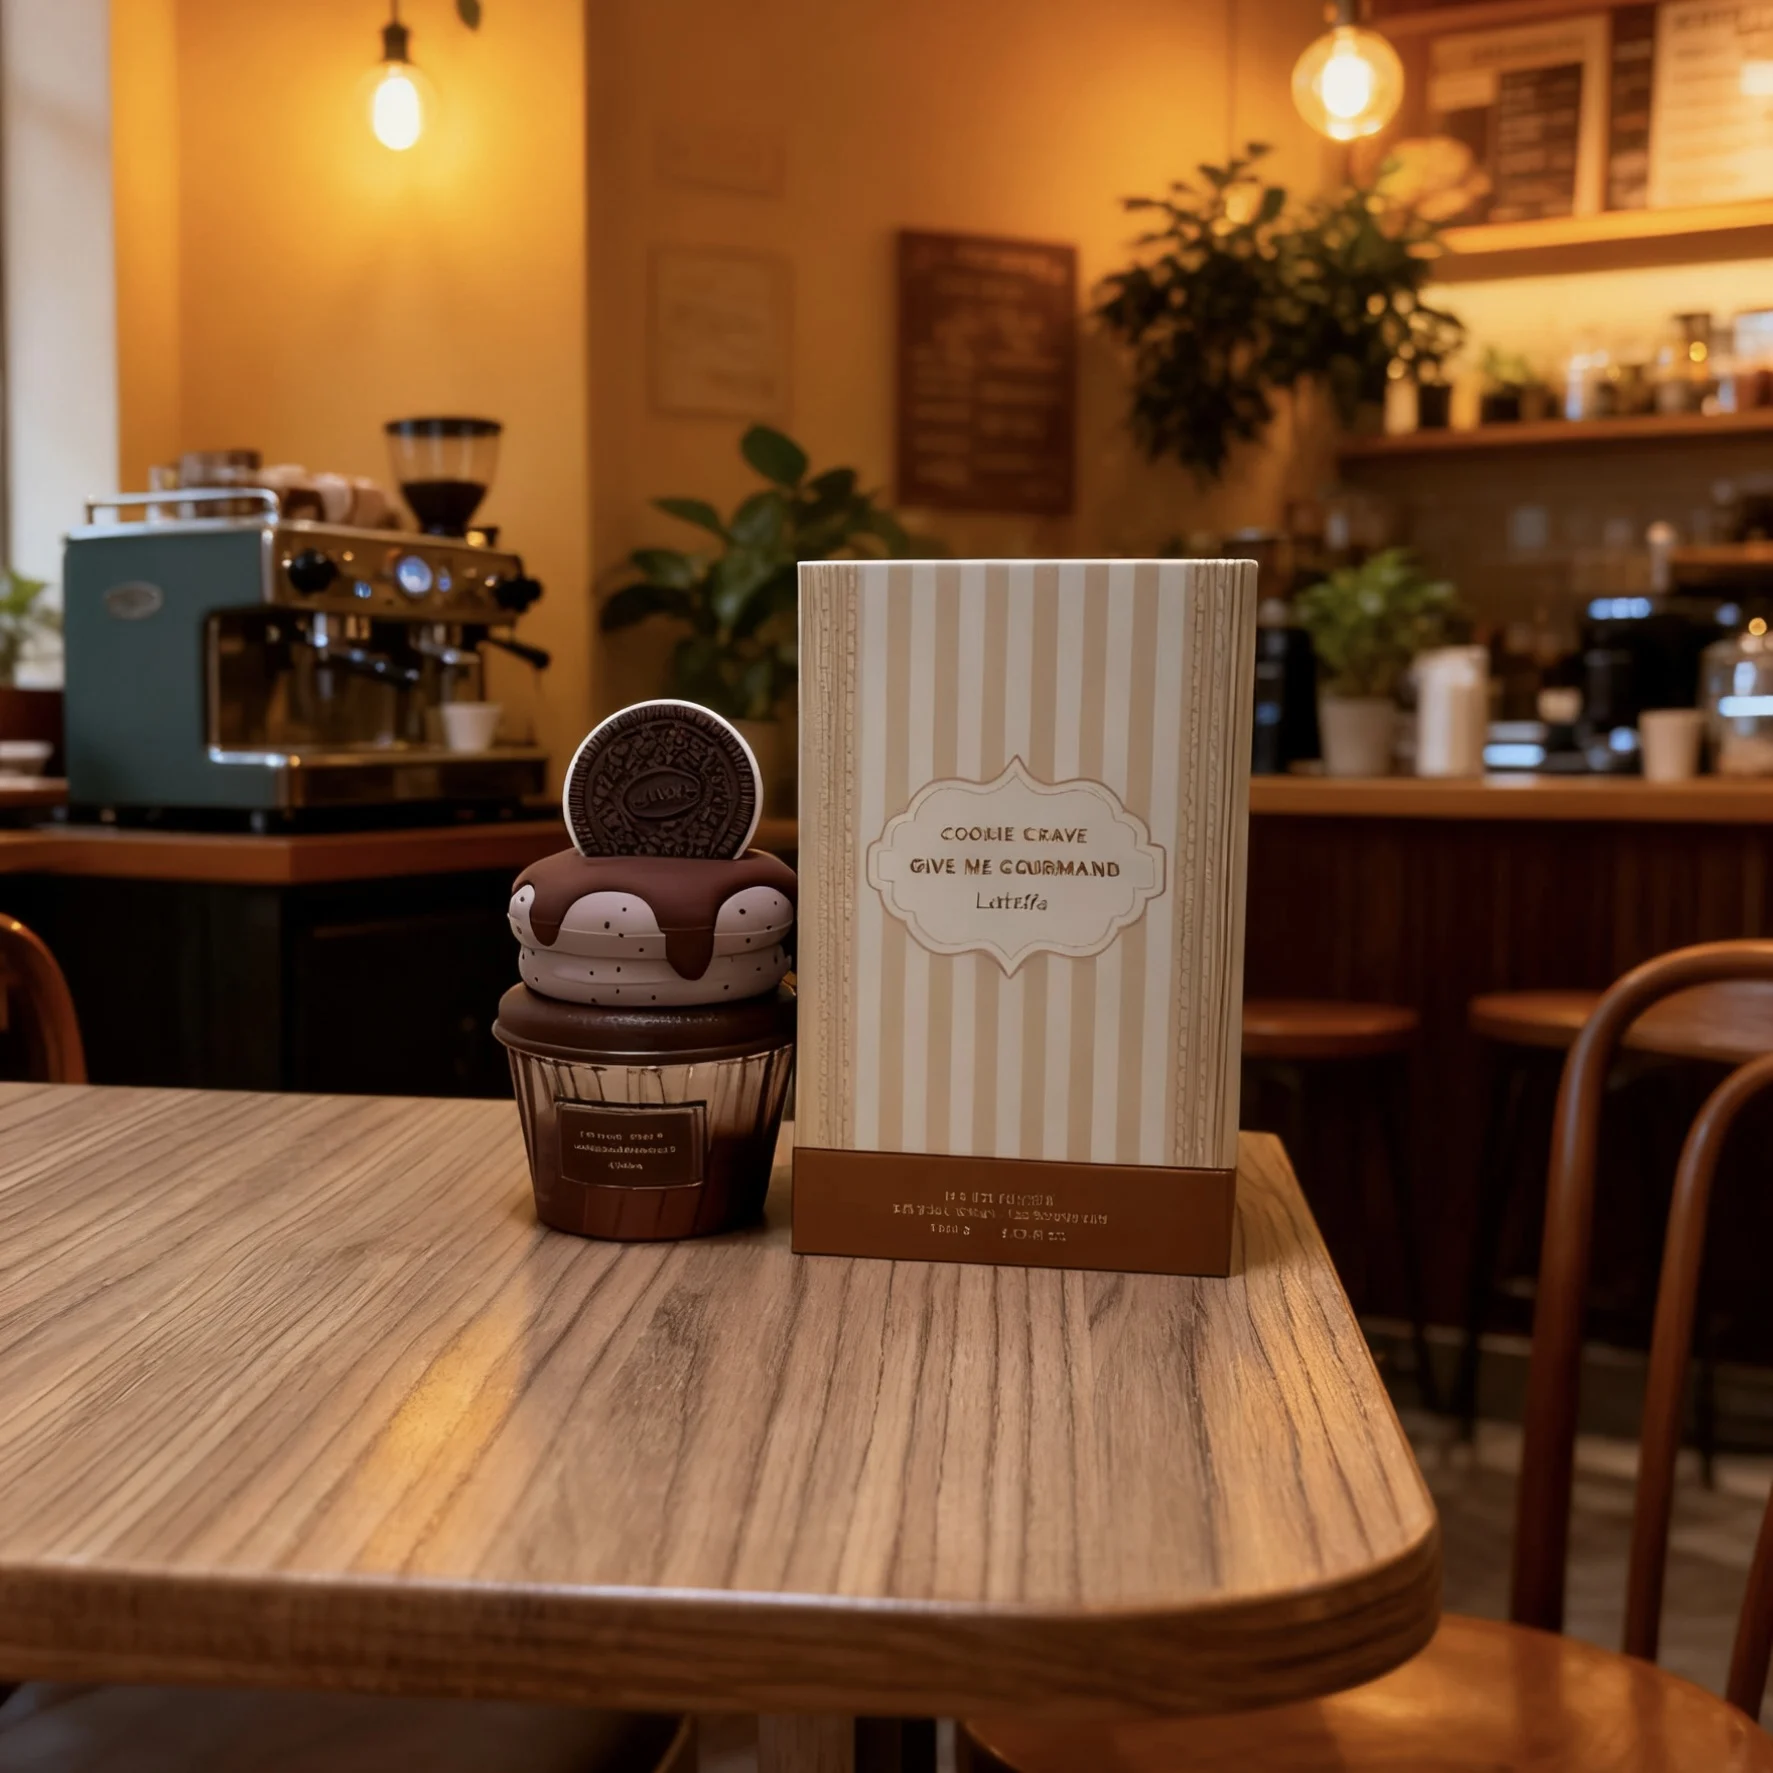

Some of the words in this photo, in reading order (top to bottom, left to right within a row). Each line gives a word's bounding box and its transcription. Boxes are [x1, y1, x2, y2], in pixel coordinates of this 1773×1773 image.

[1023, 827, 1088, 843] CRAVE
[909, 858, 956, 875] GIVE
[964, 858, 992, 875] ME
